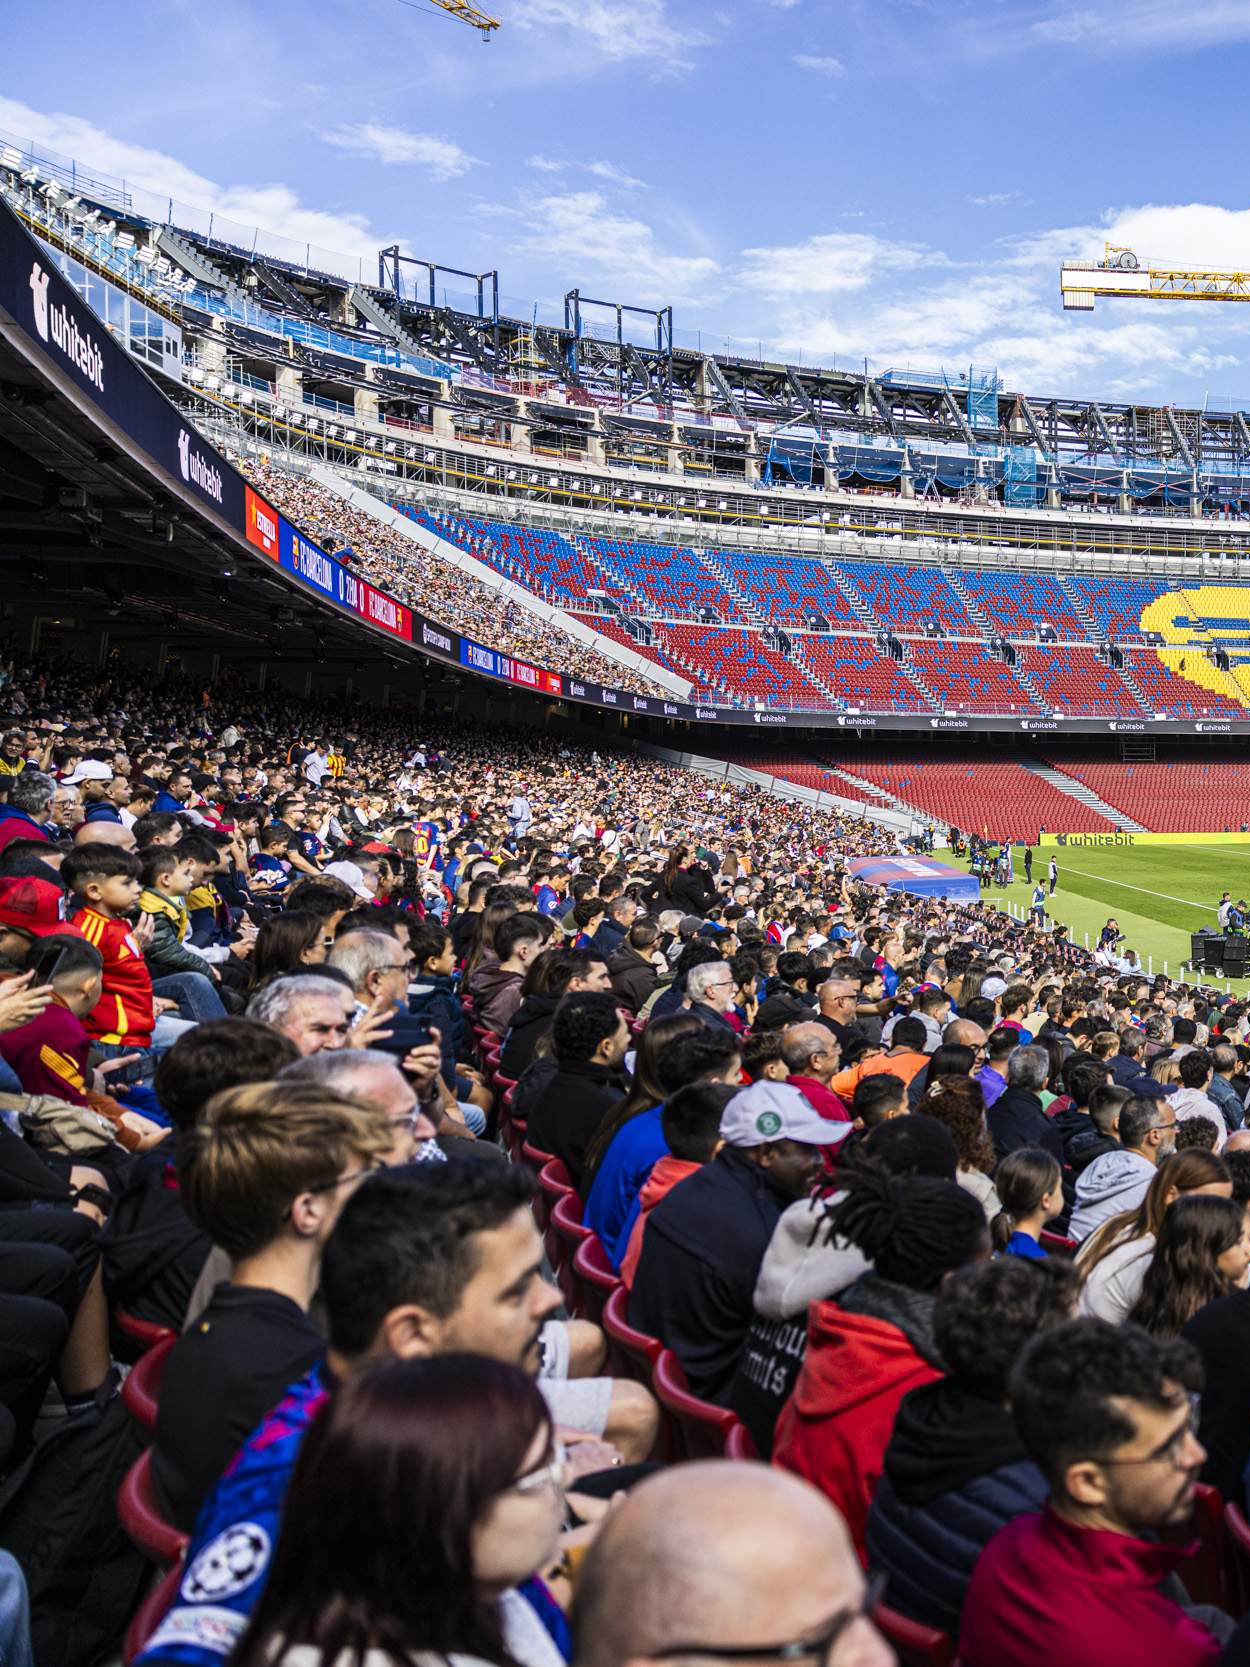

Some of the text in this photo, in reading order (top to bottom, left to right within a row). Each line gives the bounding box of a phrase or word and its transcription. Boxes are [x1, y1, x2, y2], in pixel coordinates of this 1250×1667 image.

[50, 303, 104, 392] whitebit
[189, 450, 223, 503] whitebit
[339, 569, 344, 600] 0
[360, 583, 364, 613] 0
[761, 715, 787, 723] whitebit
[846, 717, 876, 726] whitebit
[939, 719, 968, 728] whitebit
[1029, 721, 1058, 730] whitebit
[1117, 722, 1145, 731] whitebit
[1203, 723, 1231, 732] whitebit
[1070, 833, 1135, 847] whitebit
